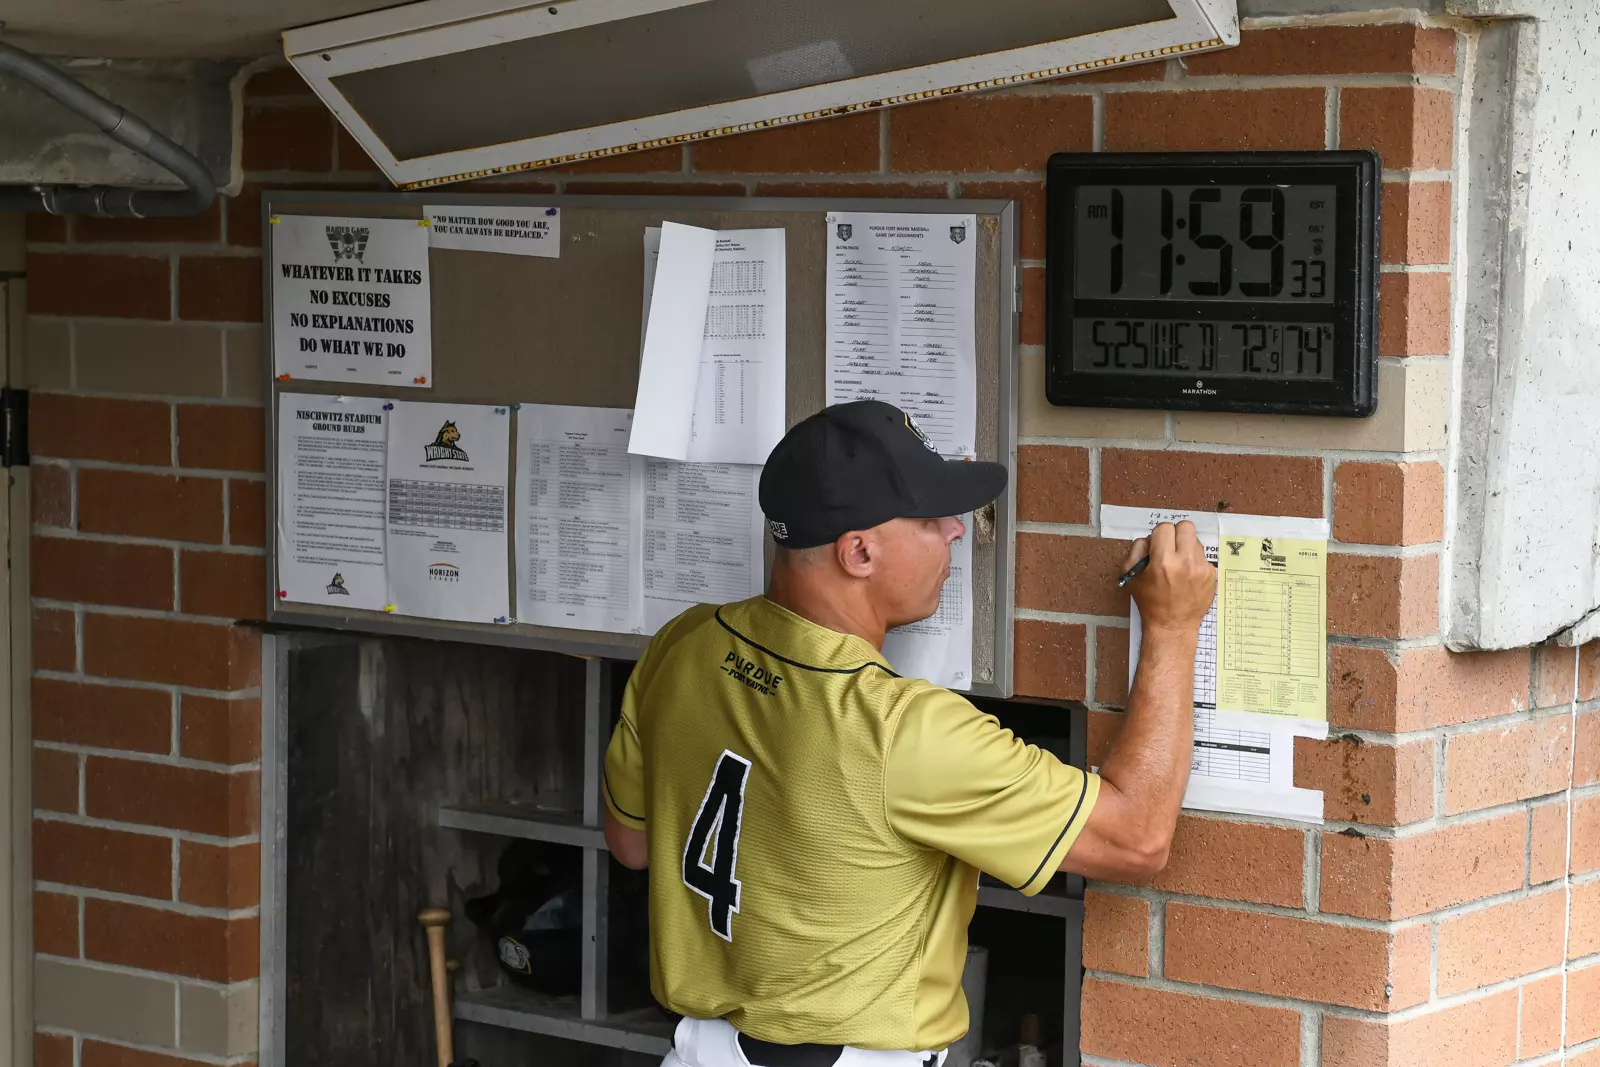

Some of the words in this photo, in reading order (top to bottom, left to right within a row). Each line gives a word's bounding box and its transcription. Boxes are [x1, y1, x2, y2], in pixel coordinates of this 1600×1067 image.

[1087, 205, 1107, 219] AM
[1309, 201, 1325, 210] EST
[325, 225, 350, 233] RAIDER
[351, 226, 370, 234] GANG
[433, 224, 448, 233] YOU
[449, 225, 464, 234] CAN
[464, 226, 492, 236] ALWAYS
[493, 229, 504, 237] BE
[448, 216, 477, 225] MATTER
[478, 217, 494, 226] HOW
[495, 219, 515, 228] GOOD
[516, 220, 531, 228] YOU
[531, 221, 550, 230] ARE,
[1110, 188, 1285, 297] 11:59
[281, 263, 355, 281] WHATEVER
[357, 267, 371, 282] IT
[374, 268, 422, 285] TAKES
[1290, 260, 1326, 298] 33
[309, 289, 329, 304] NO
[332, 290, 391, 308] EXCUSES
[290, 312, 309, 328] NO
[311, 313, 414, 334] EXPLANATIONS
[299, 337, 318, 353] DO
[320, 338, 361, 355] WHAT
[363, 341, 383, 357] WE
[386, 343, 406, 358] DO
[1154, 322, 1213, 371] WED
[296, 410, 343, 422] NISCHWITZ
[344, 413, 382, 424] STADIUM
[312, 422, 342, 432] GROUND
[343, 425, 365, 433] RULES
[426, 445, 452, 460] WRIGHT
[1226, 540, 1245, 556] Y
[429, 568, 459, 577] HORIZON
[725, 651, 783, 689] PURDUE
[728, 669, 746, 683] FORT
[745, 677, 770, 695] WAYNE
[682, 749, 752, 942] 4
